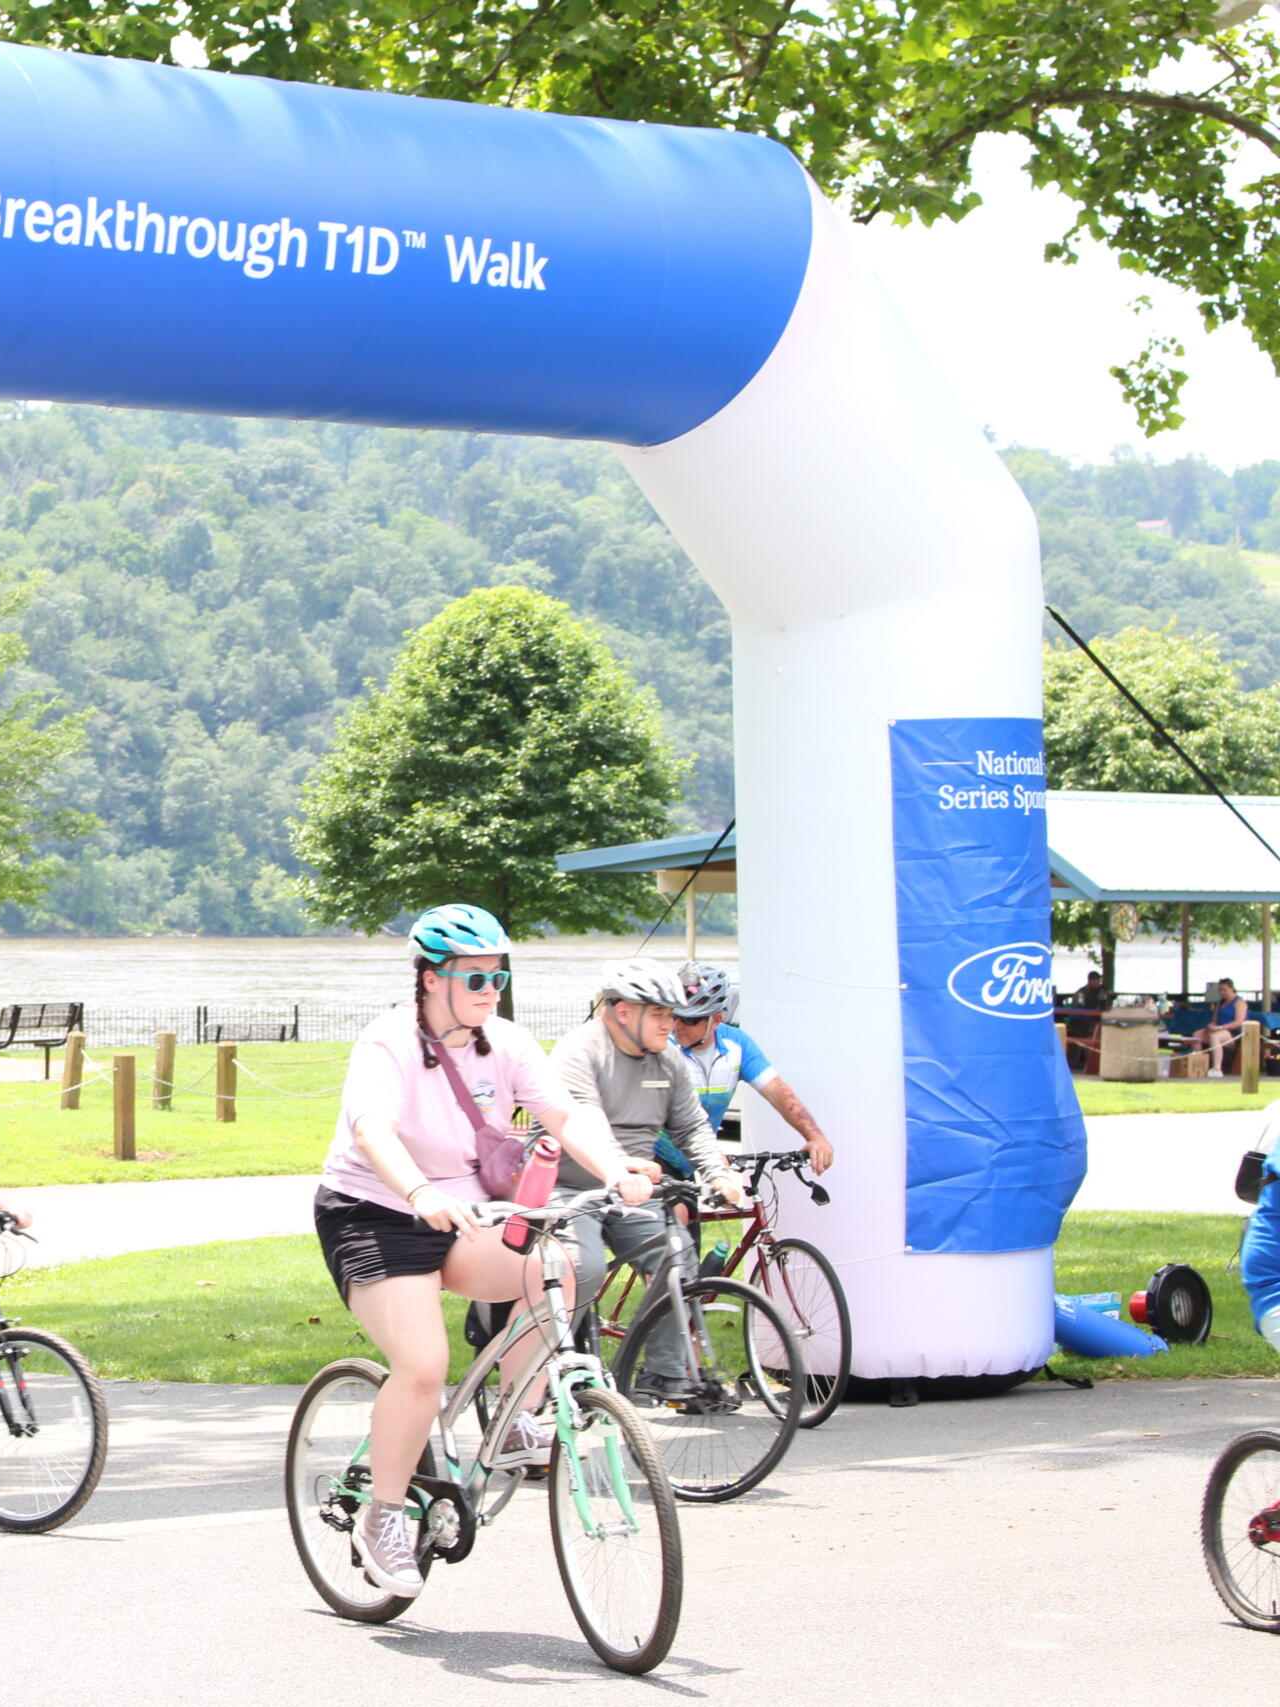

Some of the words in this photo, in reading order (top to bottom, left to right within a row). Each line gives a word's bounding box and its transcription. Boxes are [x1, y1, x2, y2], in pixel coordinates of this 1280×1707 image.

[444, 234, 549, 291] Walk
[975, 750, 1044, 776] National
[938, 784, 1010, 810] Series
